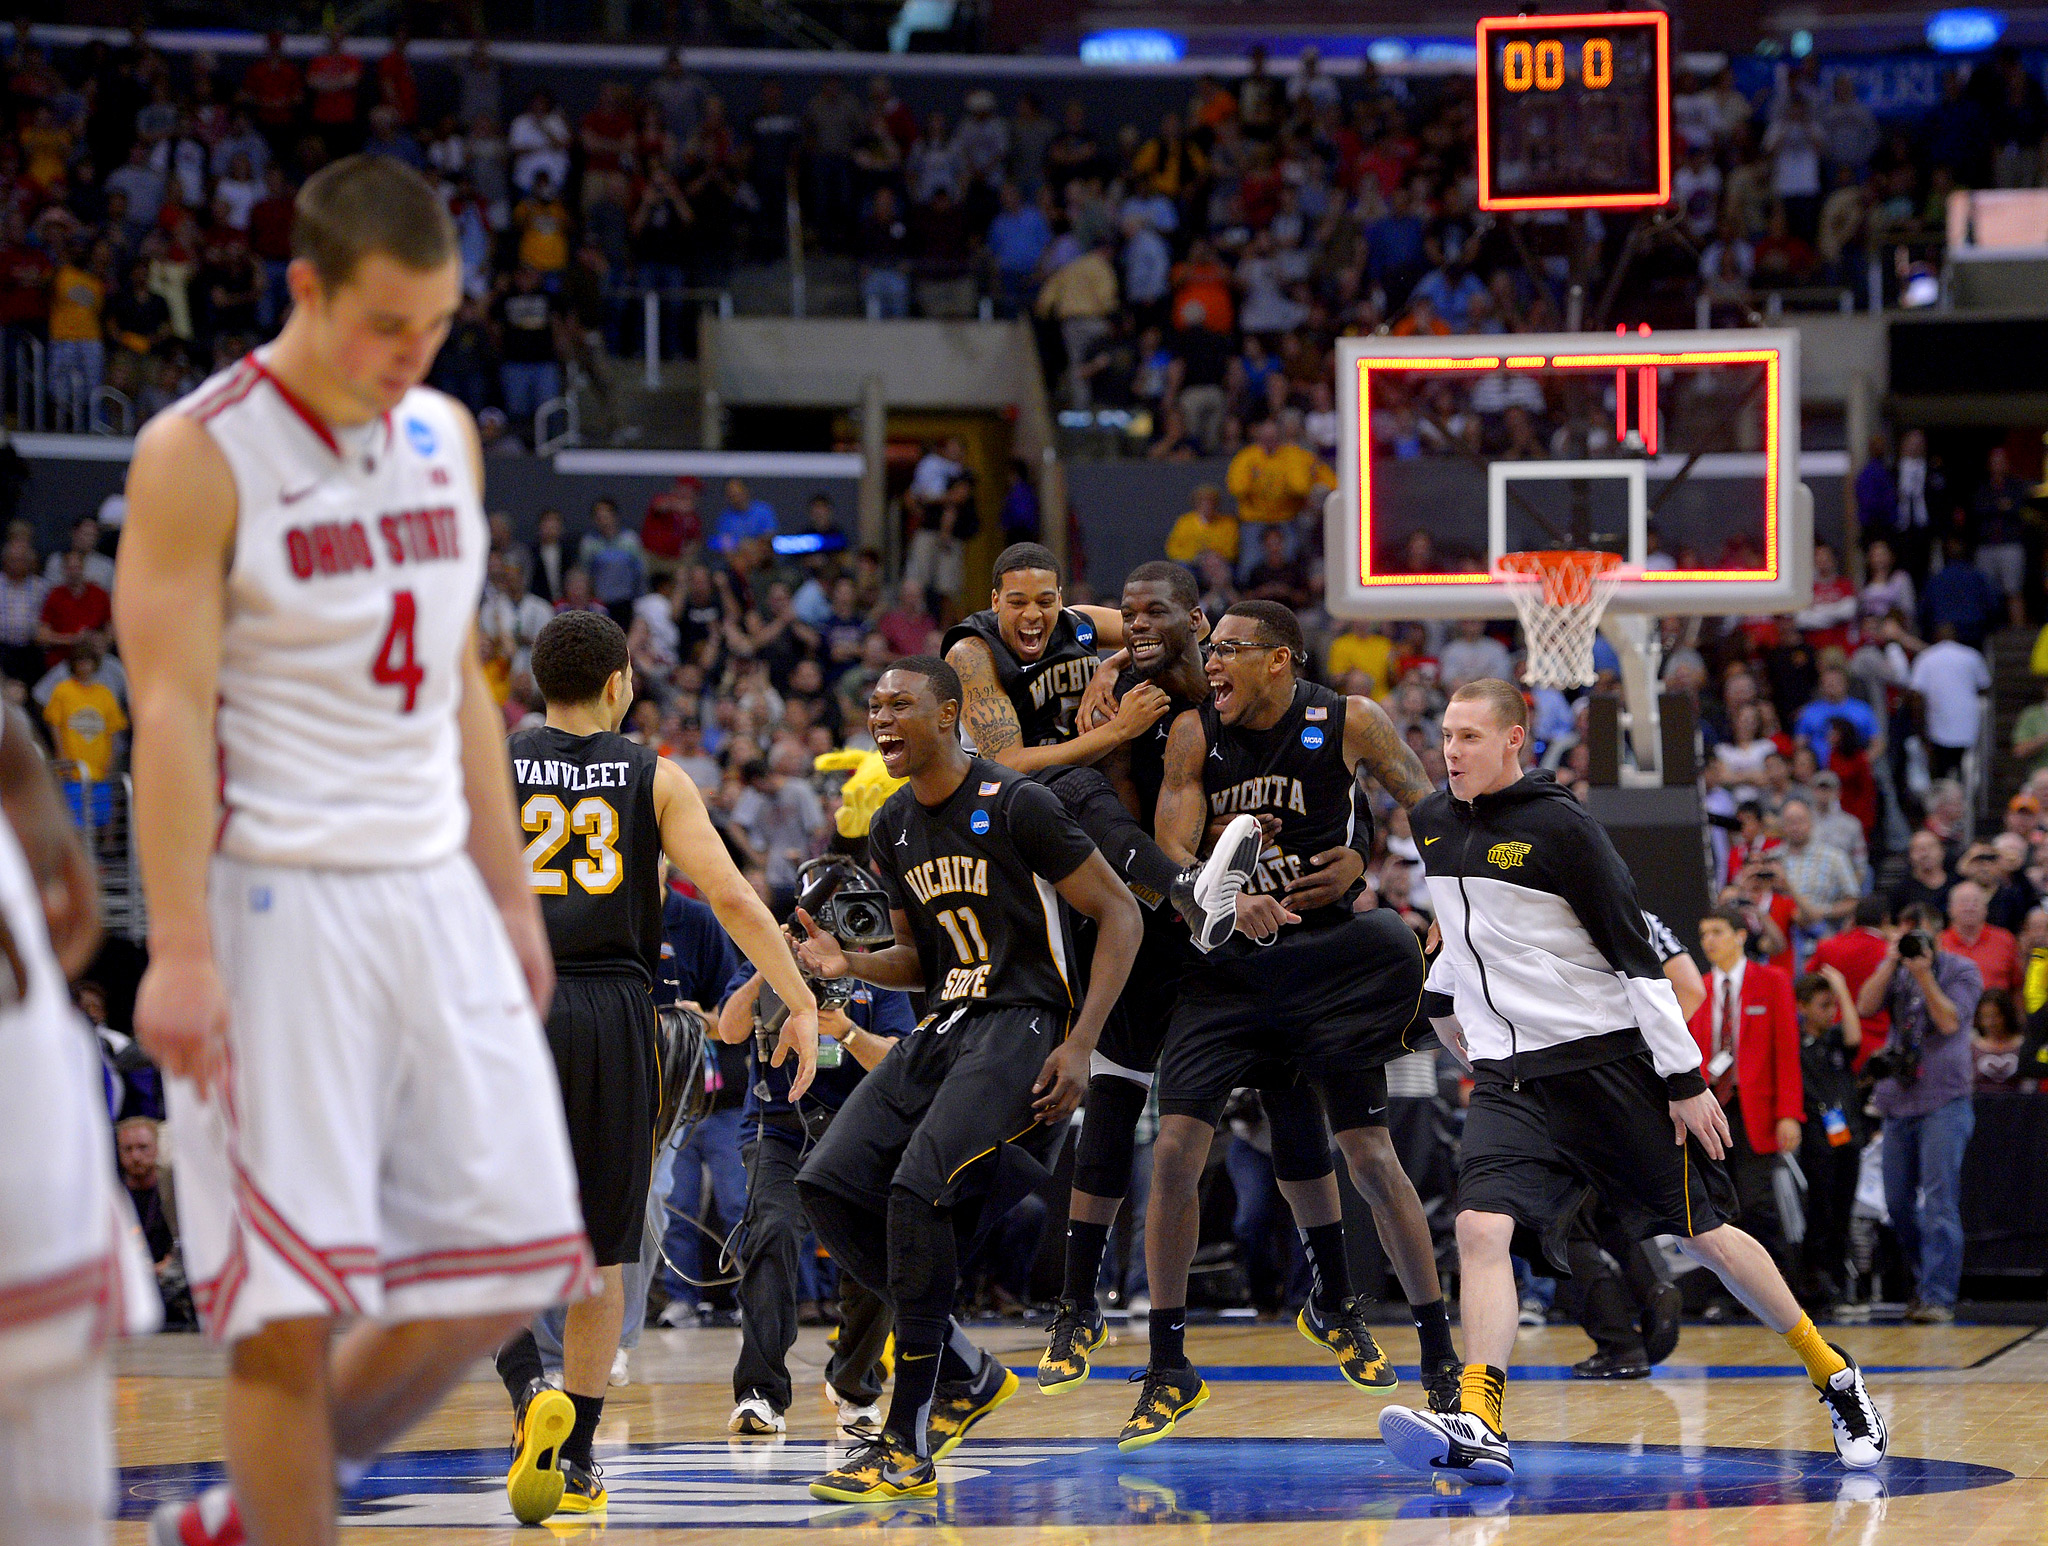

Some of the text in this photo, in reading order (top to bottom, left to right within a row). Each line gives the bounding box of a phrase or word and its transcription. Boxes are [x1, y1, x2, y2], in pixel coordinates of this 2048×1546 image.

[1503, 40, 1565, 93] 00
[1582, 37, 1614, 90] 0
[286, 508, 460, 579] OHIO STATE
[371, 589, 425, 714] 4
[1029, 656, 1101, 711] WICHIT
[1303, 735, 1323, 745] NCAA
[514, 759, 629, 791] VANVLEET
[1211, 774, 1306, 816] WICHITA
[520, 793, 624, 896] 23
[904, 855, 988, 905] WICHITA
[936, 906, 989, 965] 11
